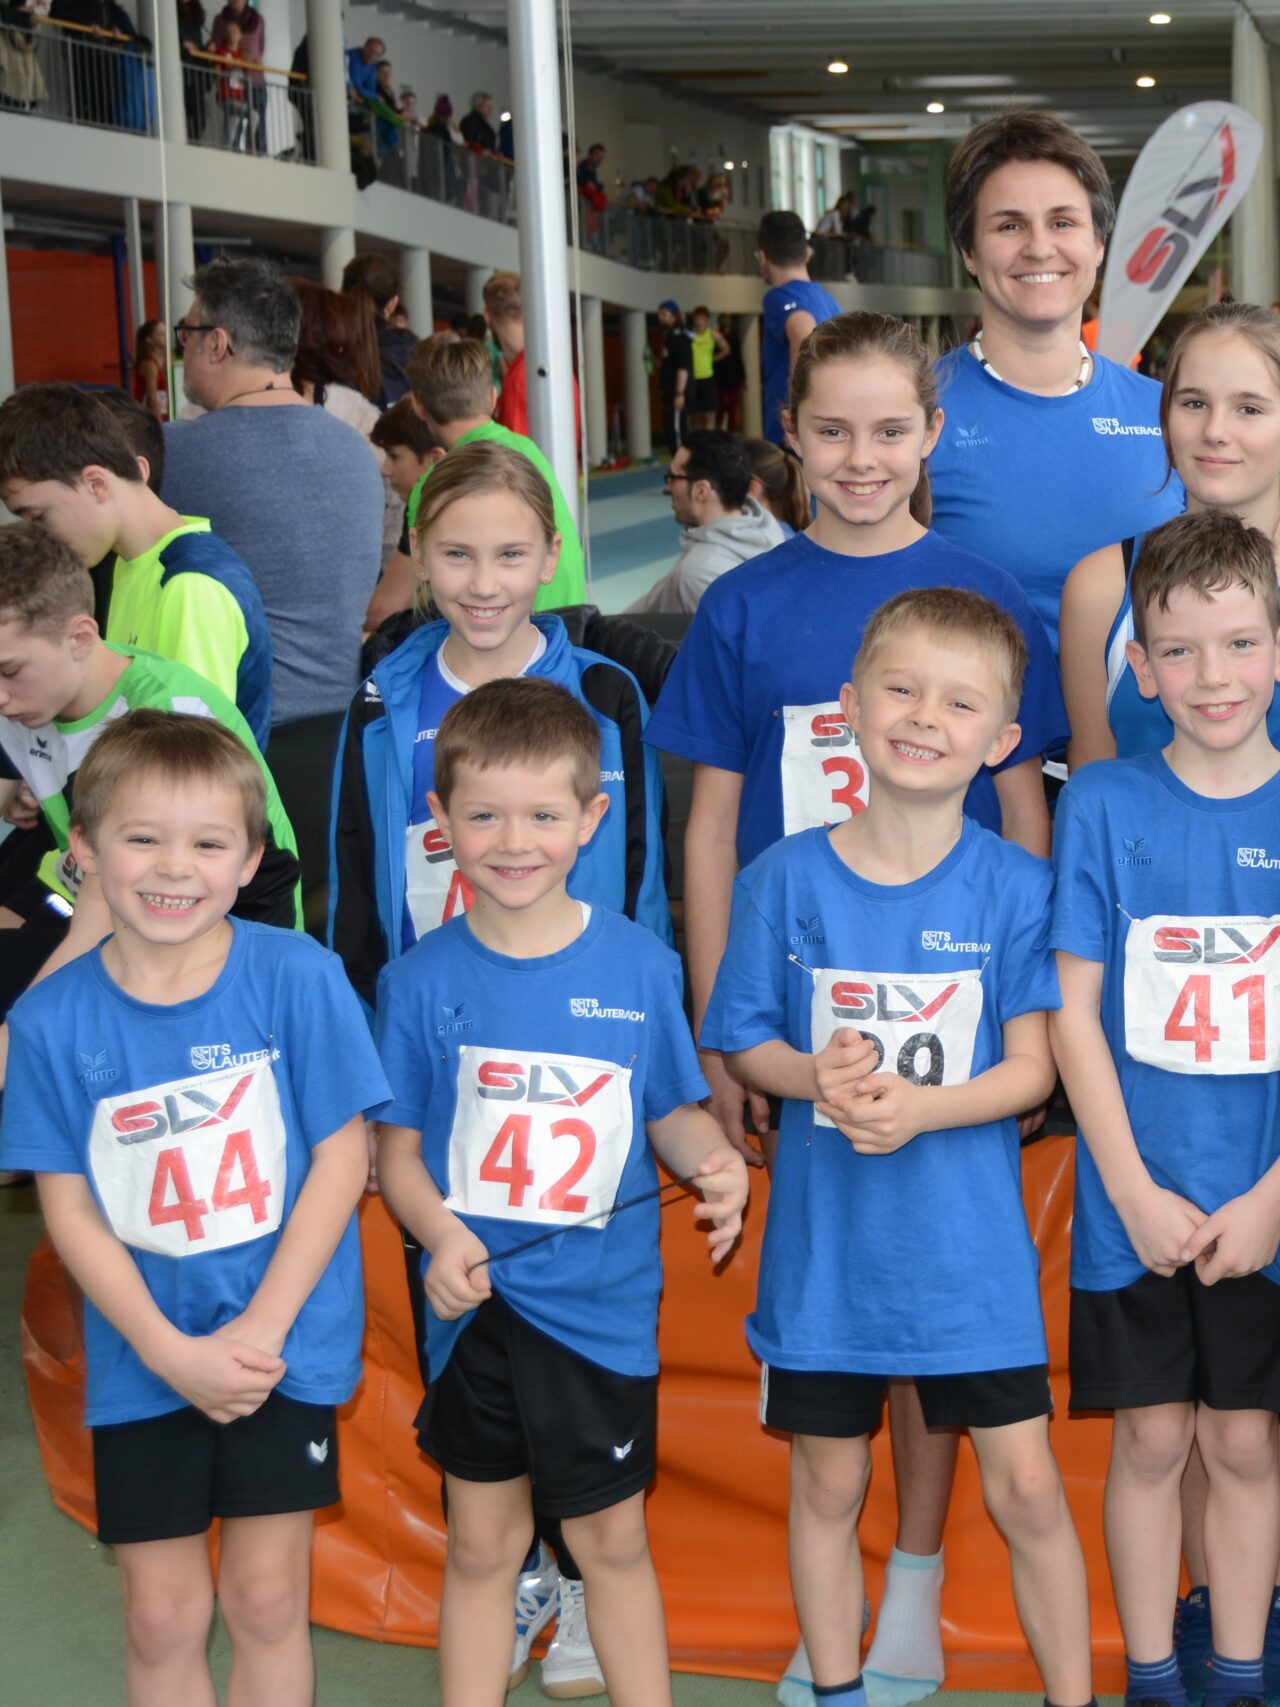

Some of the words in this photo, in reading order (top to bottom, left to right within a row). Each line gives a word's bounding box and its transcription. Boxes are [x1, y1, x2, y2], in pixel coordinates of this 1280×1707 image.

[1126, 122, 1236, 293] SLV
[1107, 418, 1119, 427] TS
[1107, 426, 1162, 436] LAUTERAC
[821, 756, 867, 826] 3
[1117, 855, 1152, 867] erima
[1252, 849, 1266, 858] TS
[937, 931, 951, 941] TS
[585, 1008, 645, 1023] LAUTERACH
[586, 998, 599, 1008] TS
[831, 981, 960, 1023] SLV
[1164, 974, 1267, 1063] 41
[212, 1044, 231, 1056] TS
[477, 1060, 615, 1107] SLV
[111, 1073, 255, 1146] SLV
[479, 1113, 597, 1213] 42
[148, 1128, 272, 1242] 44
